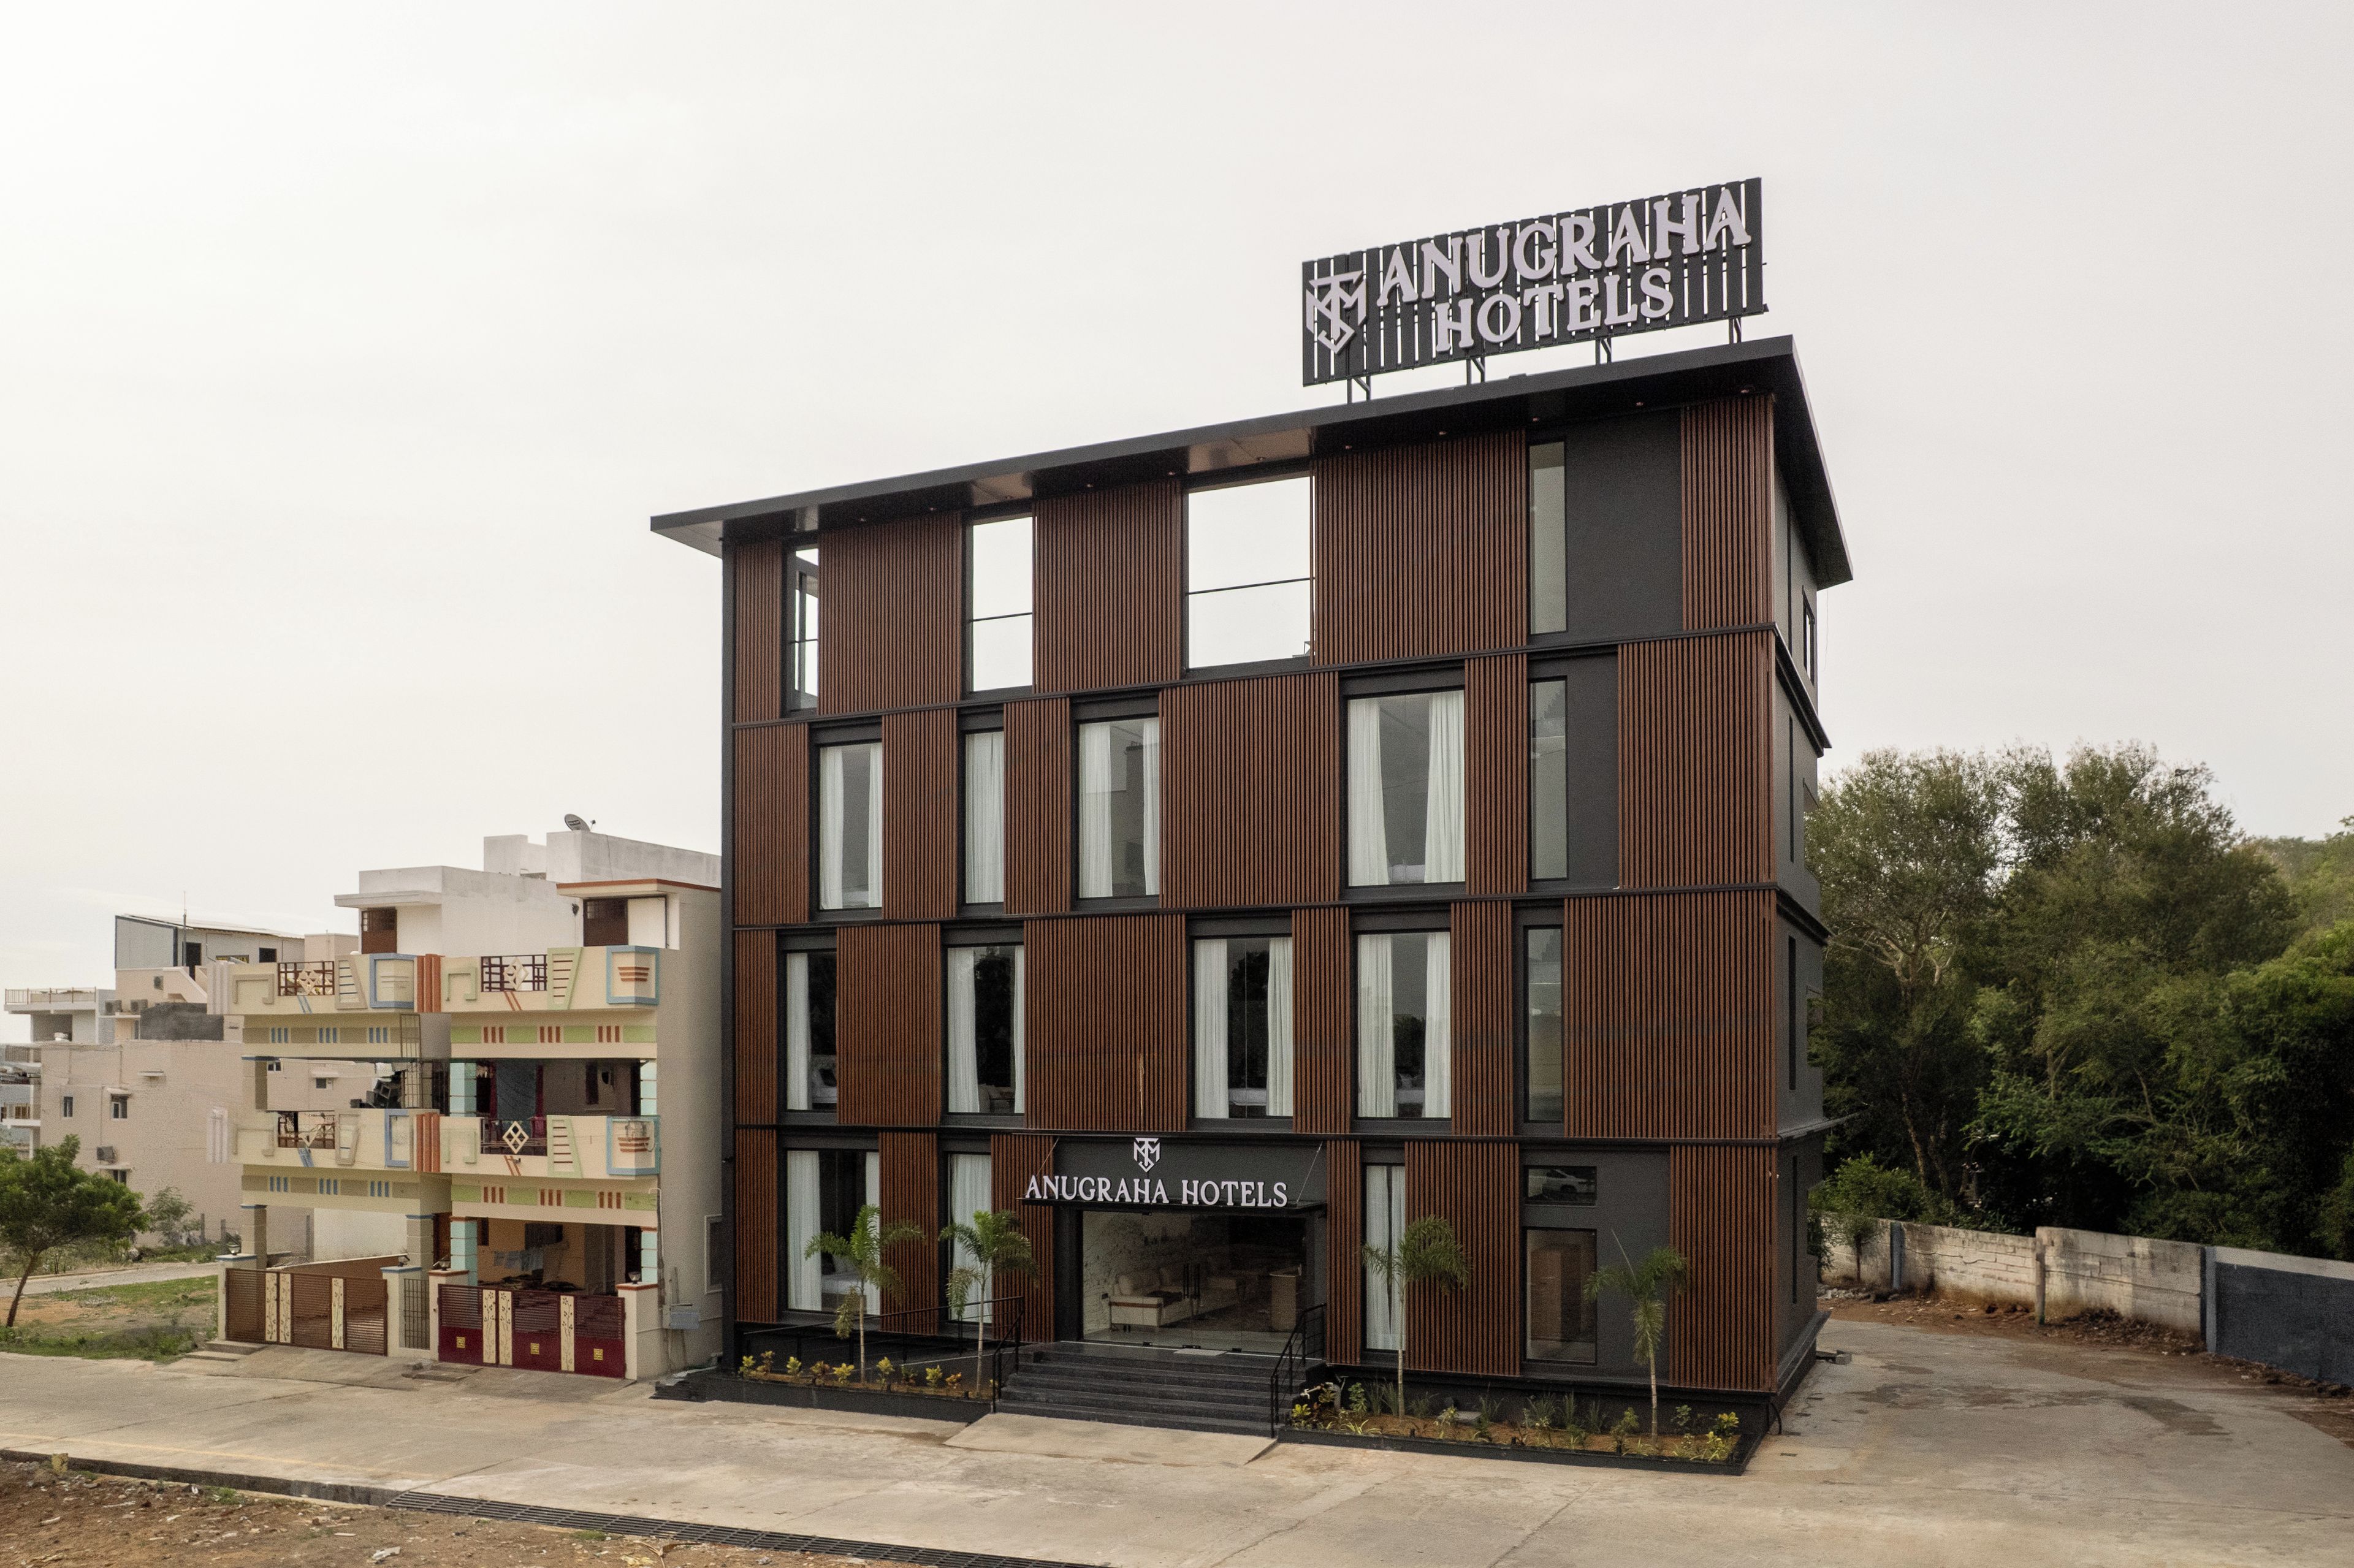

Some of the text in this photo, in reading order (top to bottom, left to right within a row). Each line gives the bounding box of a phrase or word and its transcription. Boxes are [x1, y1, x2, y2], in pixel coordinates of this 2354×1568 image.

[1377, 189, 1752, 307] ANUGRAHA
[1435, 268, 1674, 352] HOTELS
[1025, 1174, 1288, 1208] ANUGRAHA HOTELS
